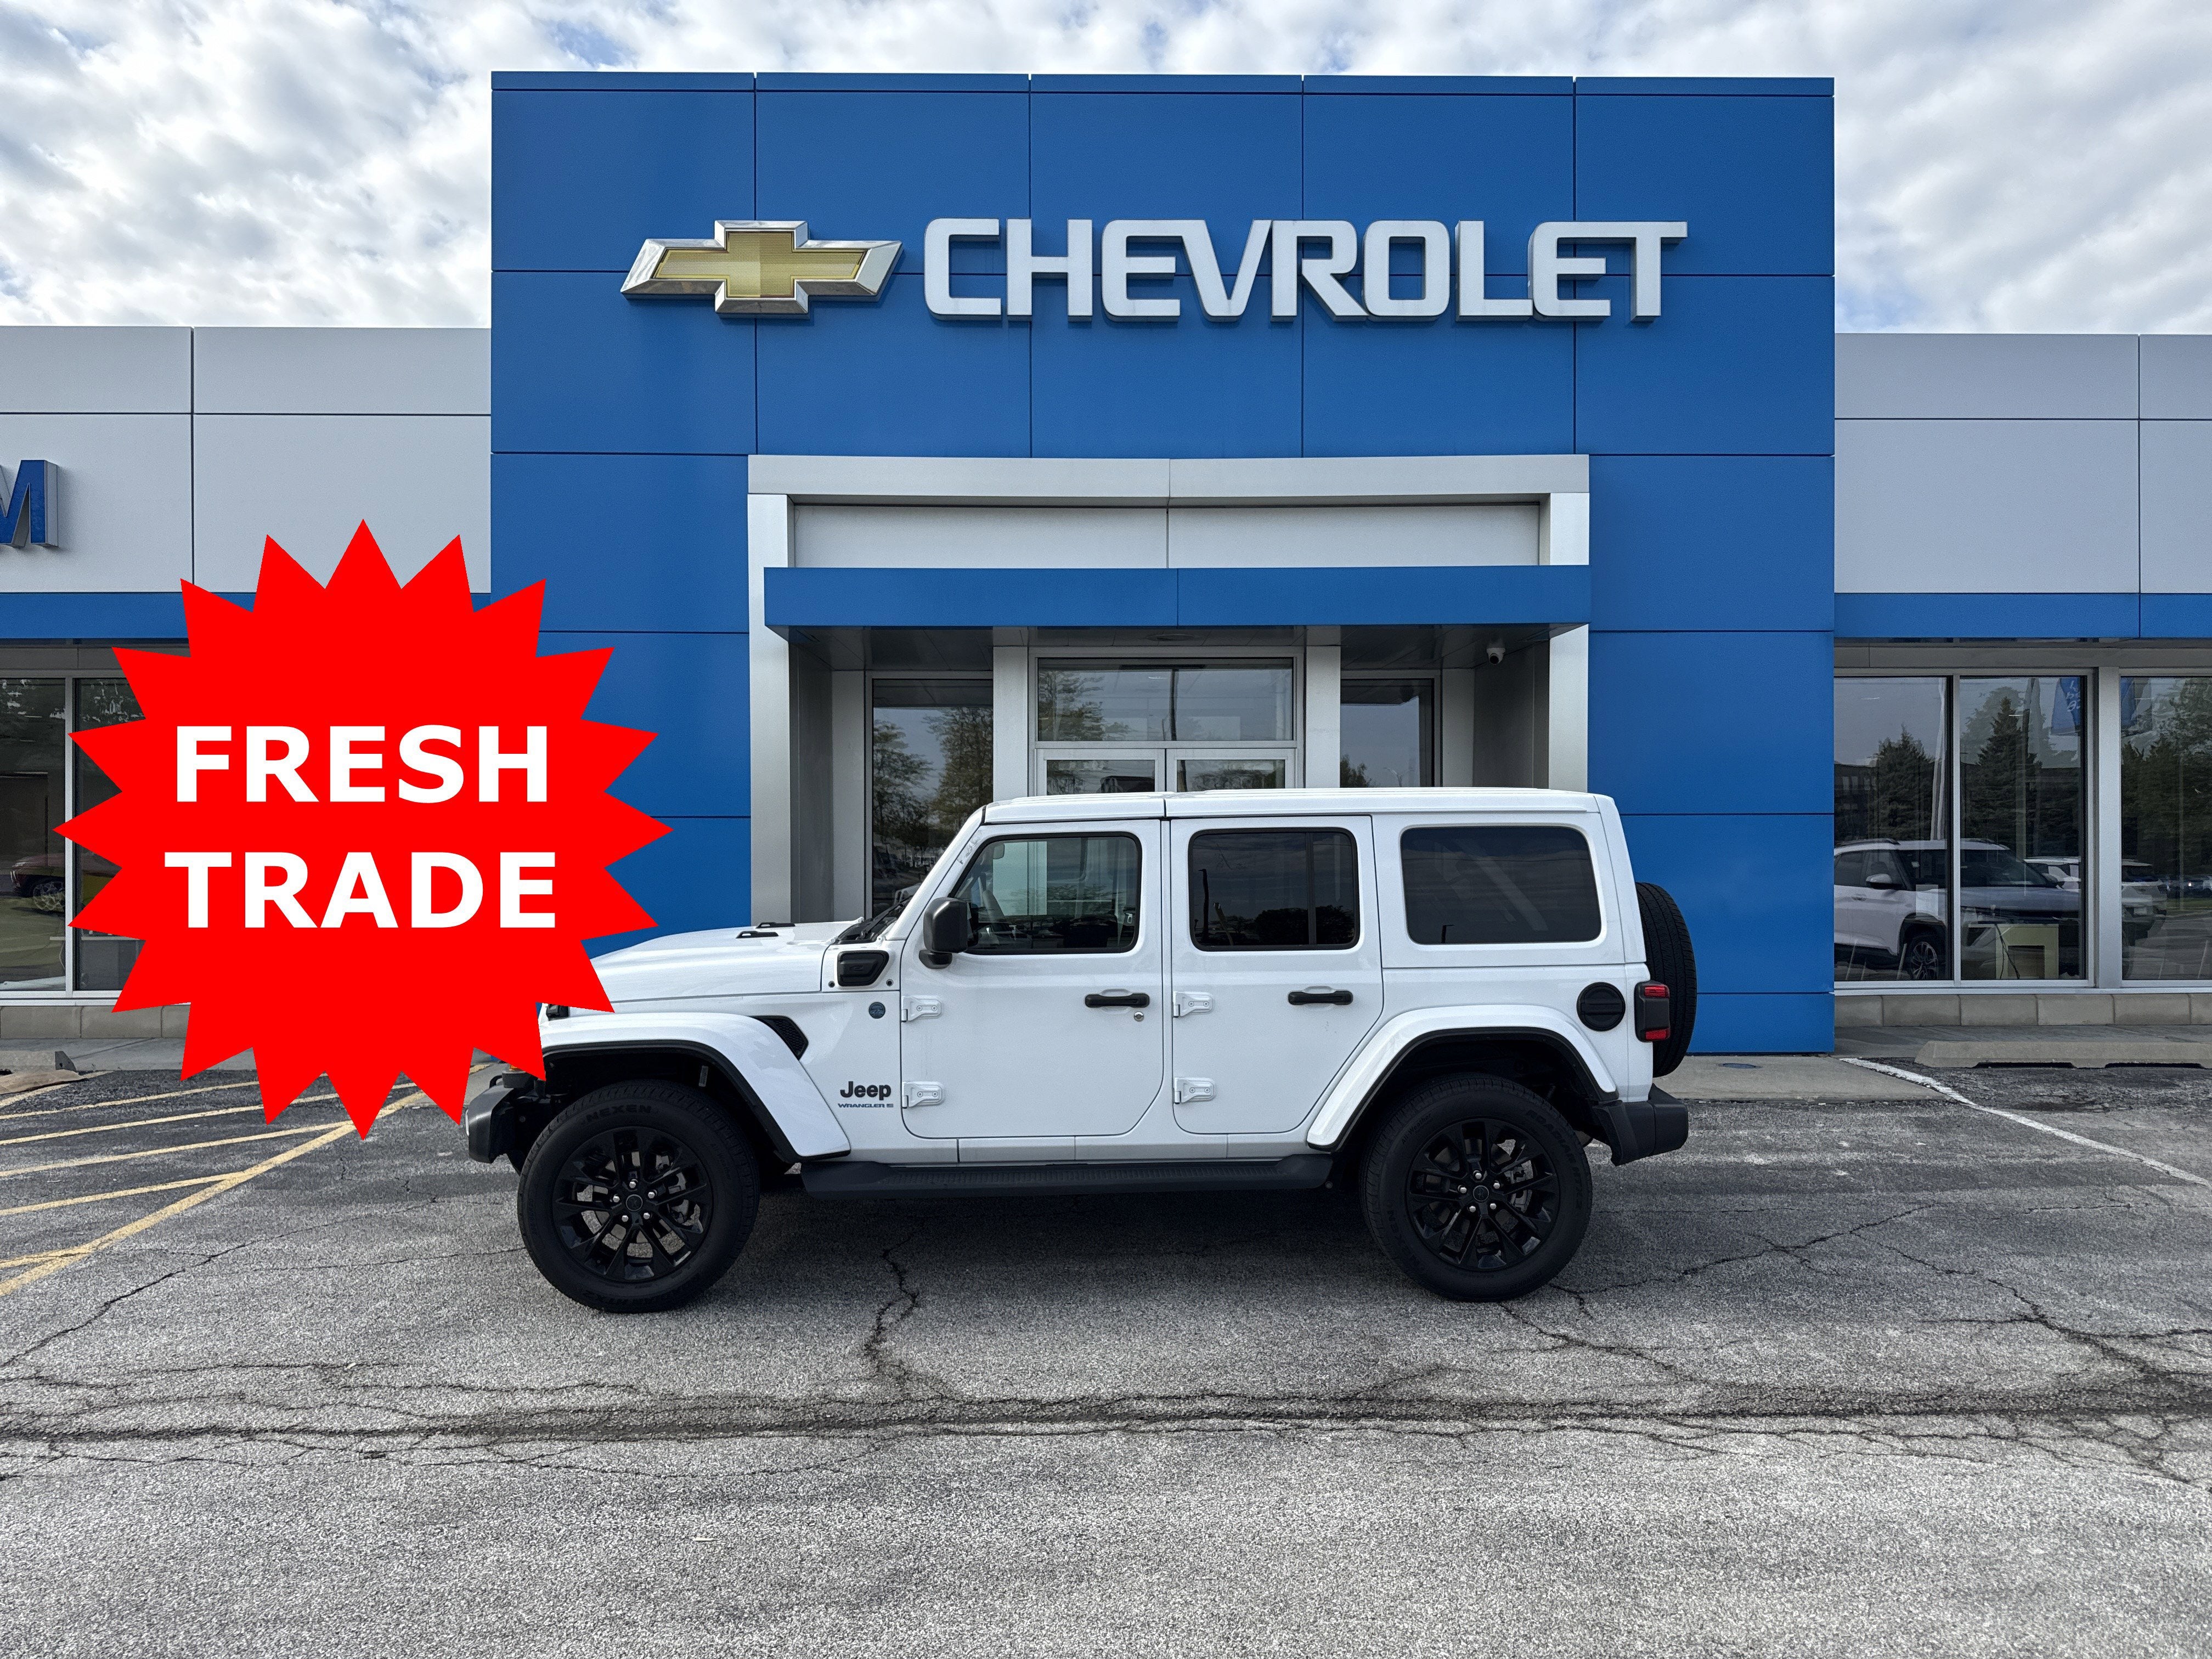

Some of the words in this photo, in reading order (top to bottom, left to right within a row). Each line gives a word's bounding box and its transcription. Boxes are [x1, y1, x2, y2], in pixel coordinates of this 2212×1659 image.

[924, 218, 1688, 320] CHEVROLET
[840, 1081, 891, 1101] Jeep
[586, 1104, 652, 1121] NEXEN
